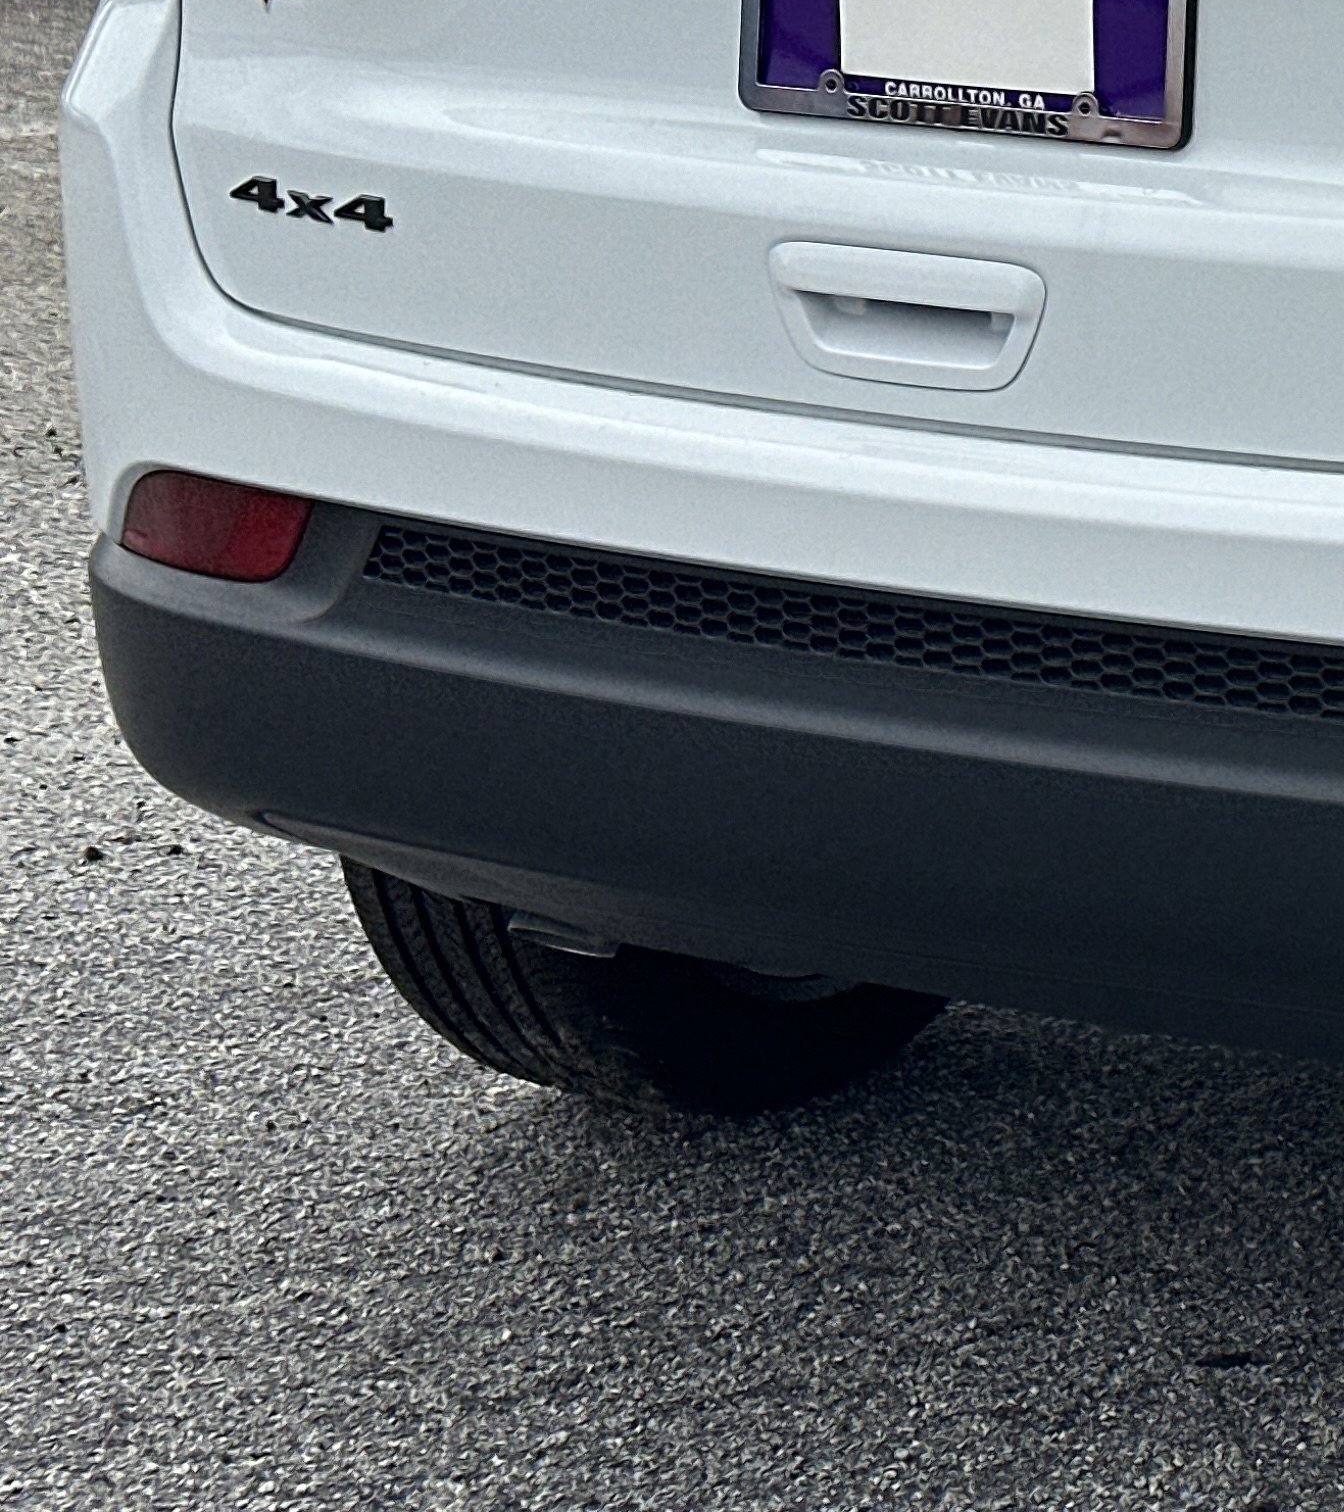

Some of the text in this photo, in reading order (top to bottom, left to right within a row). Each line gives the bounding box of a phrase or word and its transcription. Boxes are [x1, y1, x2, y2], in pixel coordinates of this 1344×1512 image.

[847, 95, 1069, 136] SCOTT EVANS
[1018, 93, 1045, 110] GA
[230, 175, 393, 233] 4x4
